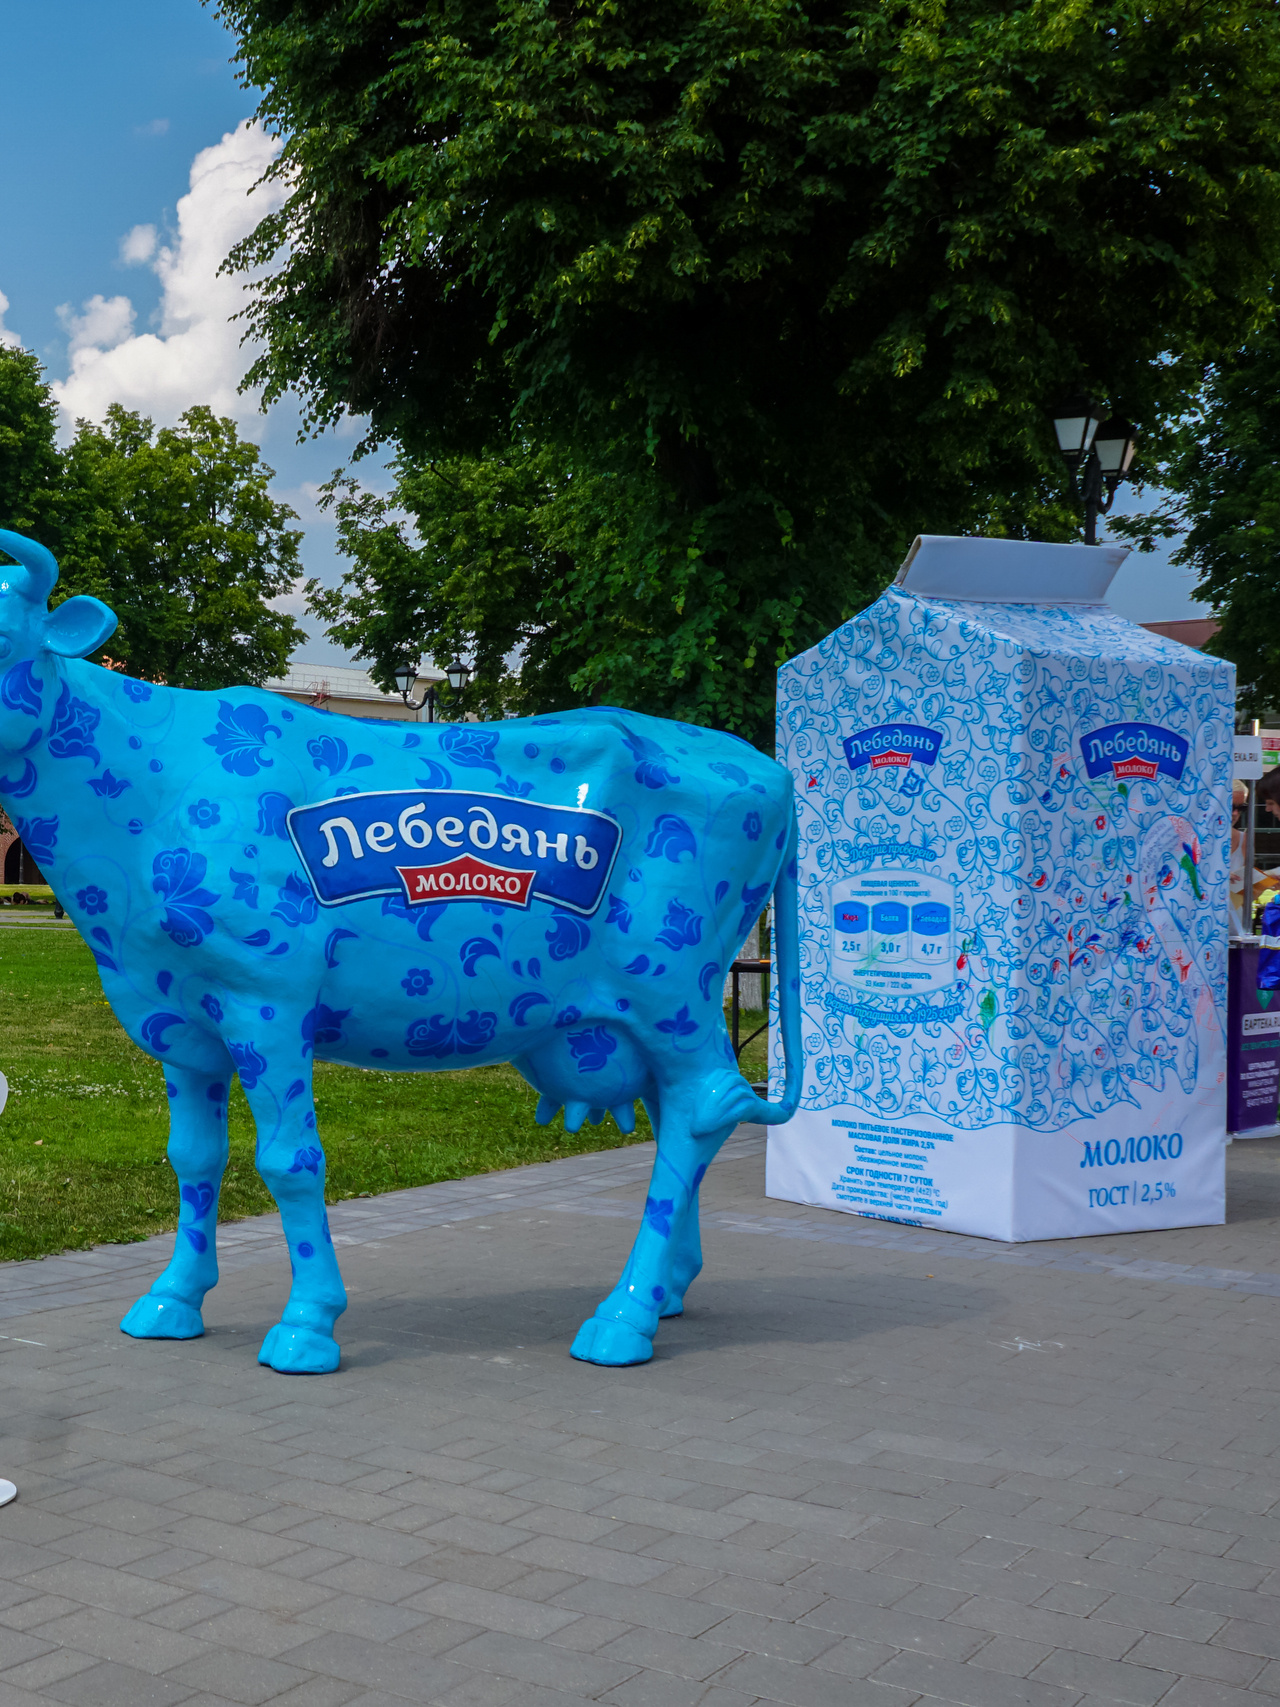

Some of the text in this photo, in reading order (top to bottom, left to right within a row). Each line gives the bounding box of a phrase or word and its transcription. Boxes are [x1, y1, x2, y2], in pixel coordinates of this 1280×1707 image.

[850, 728, 935, 759] Лебедянь
[1088, 729, 1182, 763] Лебедянь
[319, 801, 599, 870] Лебедянь
[850, 843, 937, 862] Доверие проверено
[842, 941, 855, 952] 2,5
[880, 942, 895, 954] 3,0
[921, 943, 935, 955] 4,7
[825, 992, 852, 1014] Верны
[915, 1005, 938, 1022] 1925
[938, 1003, 962, 1022] года
[831, 1119, 955, 1142] МОЛОКО ПИТЬЕВОЕ ПАСТЕРИЗОВАННОЕ
[848, 1131, 881, 1142] МАССОВАЯ
[882, 1135, 900, 1145] ДОЛЯ
[901, 1138, 919, 1148] ЖИРА
[854, 1144, 877, 1155] Состав:
[878, 1149, 903, 1159] цельное
[1080, 1132, 1183, 1168] МОЛОКО
[831, 1181, 845, 1191] Дата
[839, 1174, 863, 1185] Хранить
[864, 1179, 875, 1188] при
[876, 1181, 915, 1194] температуре
[846, 1166, 933, 1187] СРОК ГОДНОСТИ 7 СУТОК
[836, 1193, 863, 1203] смотрите
[869, 1198, 893, 1208] верхней
[894, 1202, 912, 1211] части
[913, 1205, 942, 1216] упаковки
[1089, 1181, 1176, 1208] ГОСТ 2,5%
